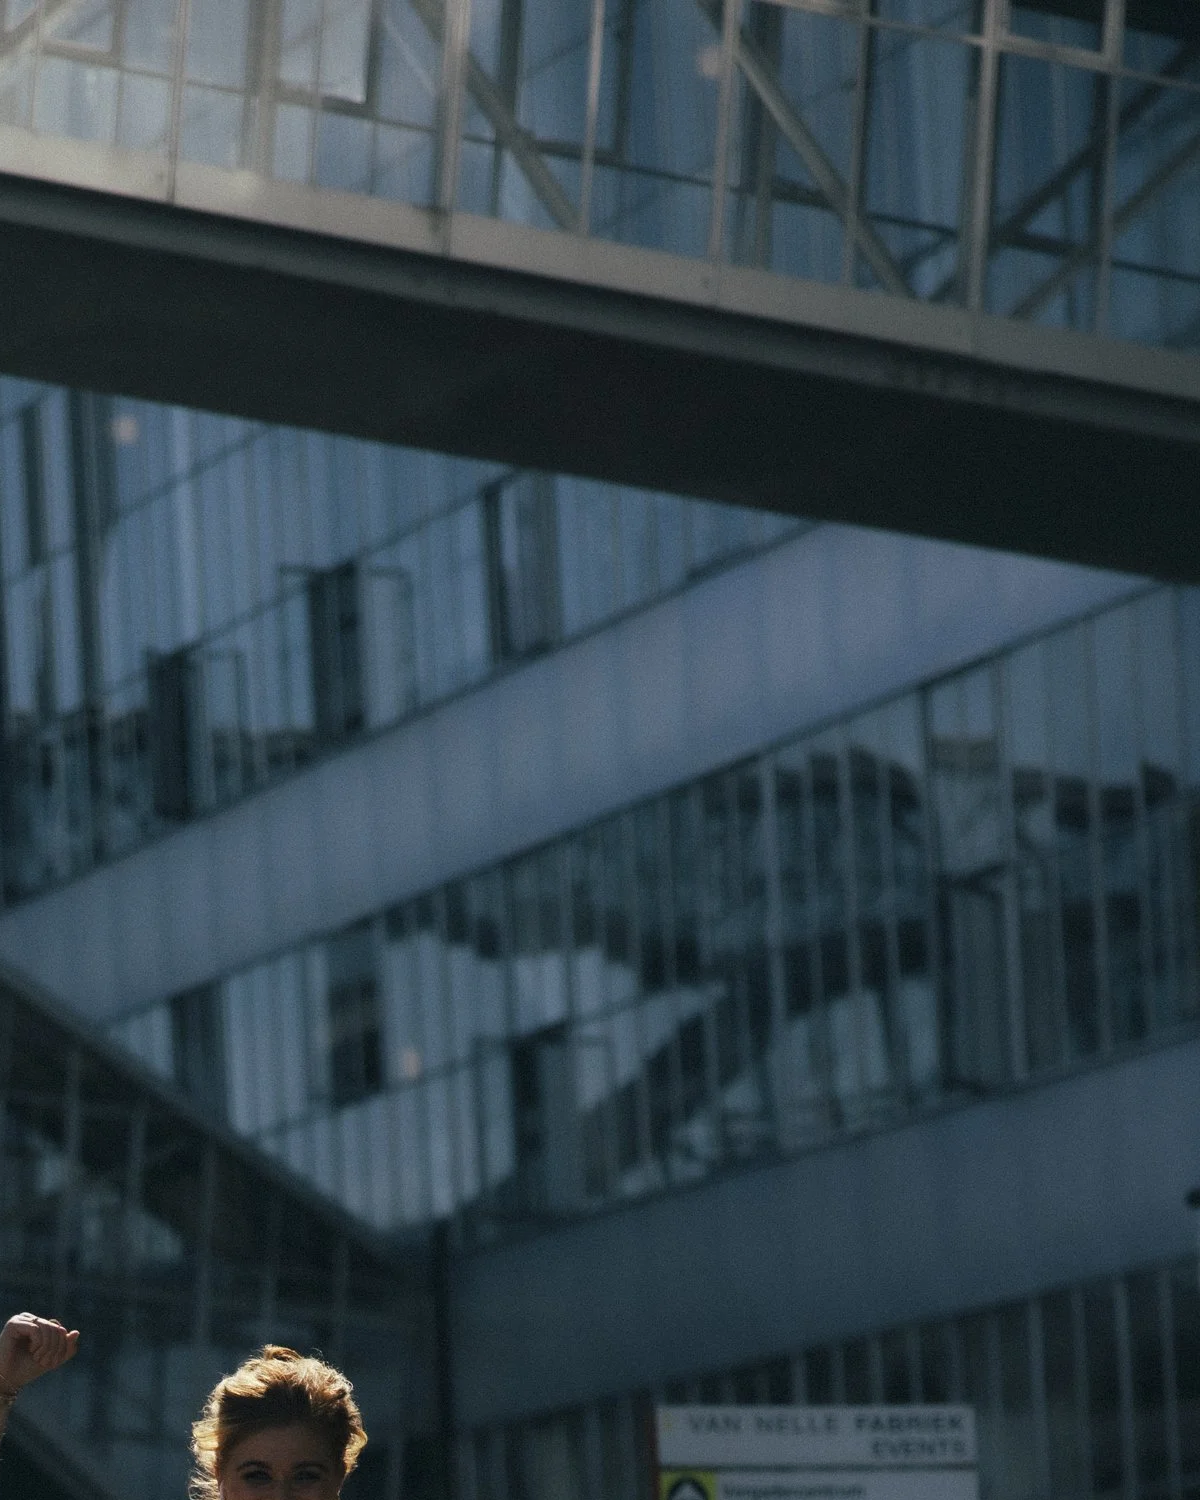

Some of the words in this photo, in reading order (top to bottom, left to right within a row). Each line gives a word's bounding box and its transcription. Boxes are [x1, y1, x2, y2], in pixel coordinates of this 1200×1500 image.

[689, 1414, 742, 1434] VAN
[755, 1414, 839, 1435] NELLE
[870, 1438, 967, 1459] EVENTS
